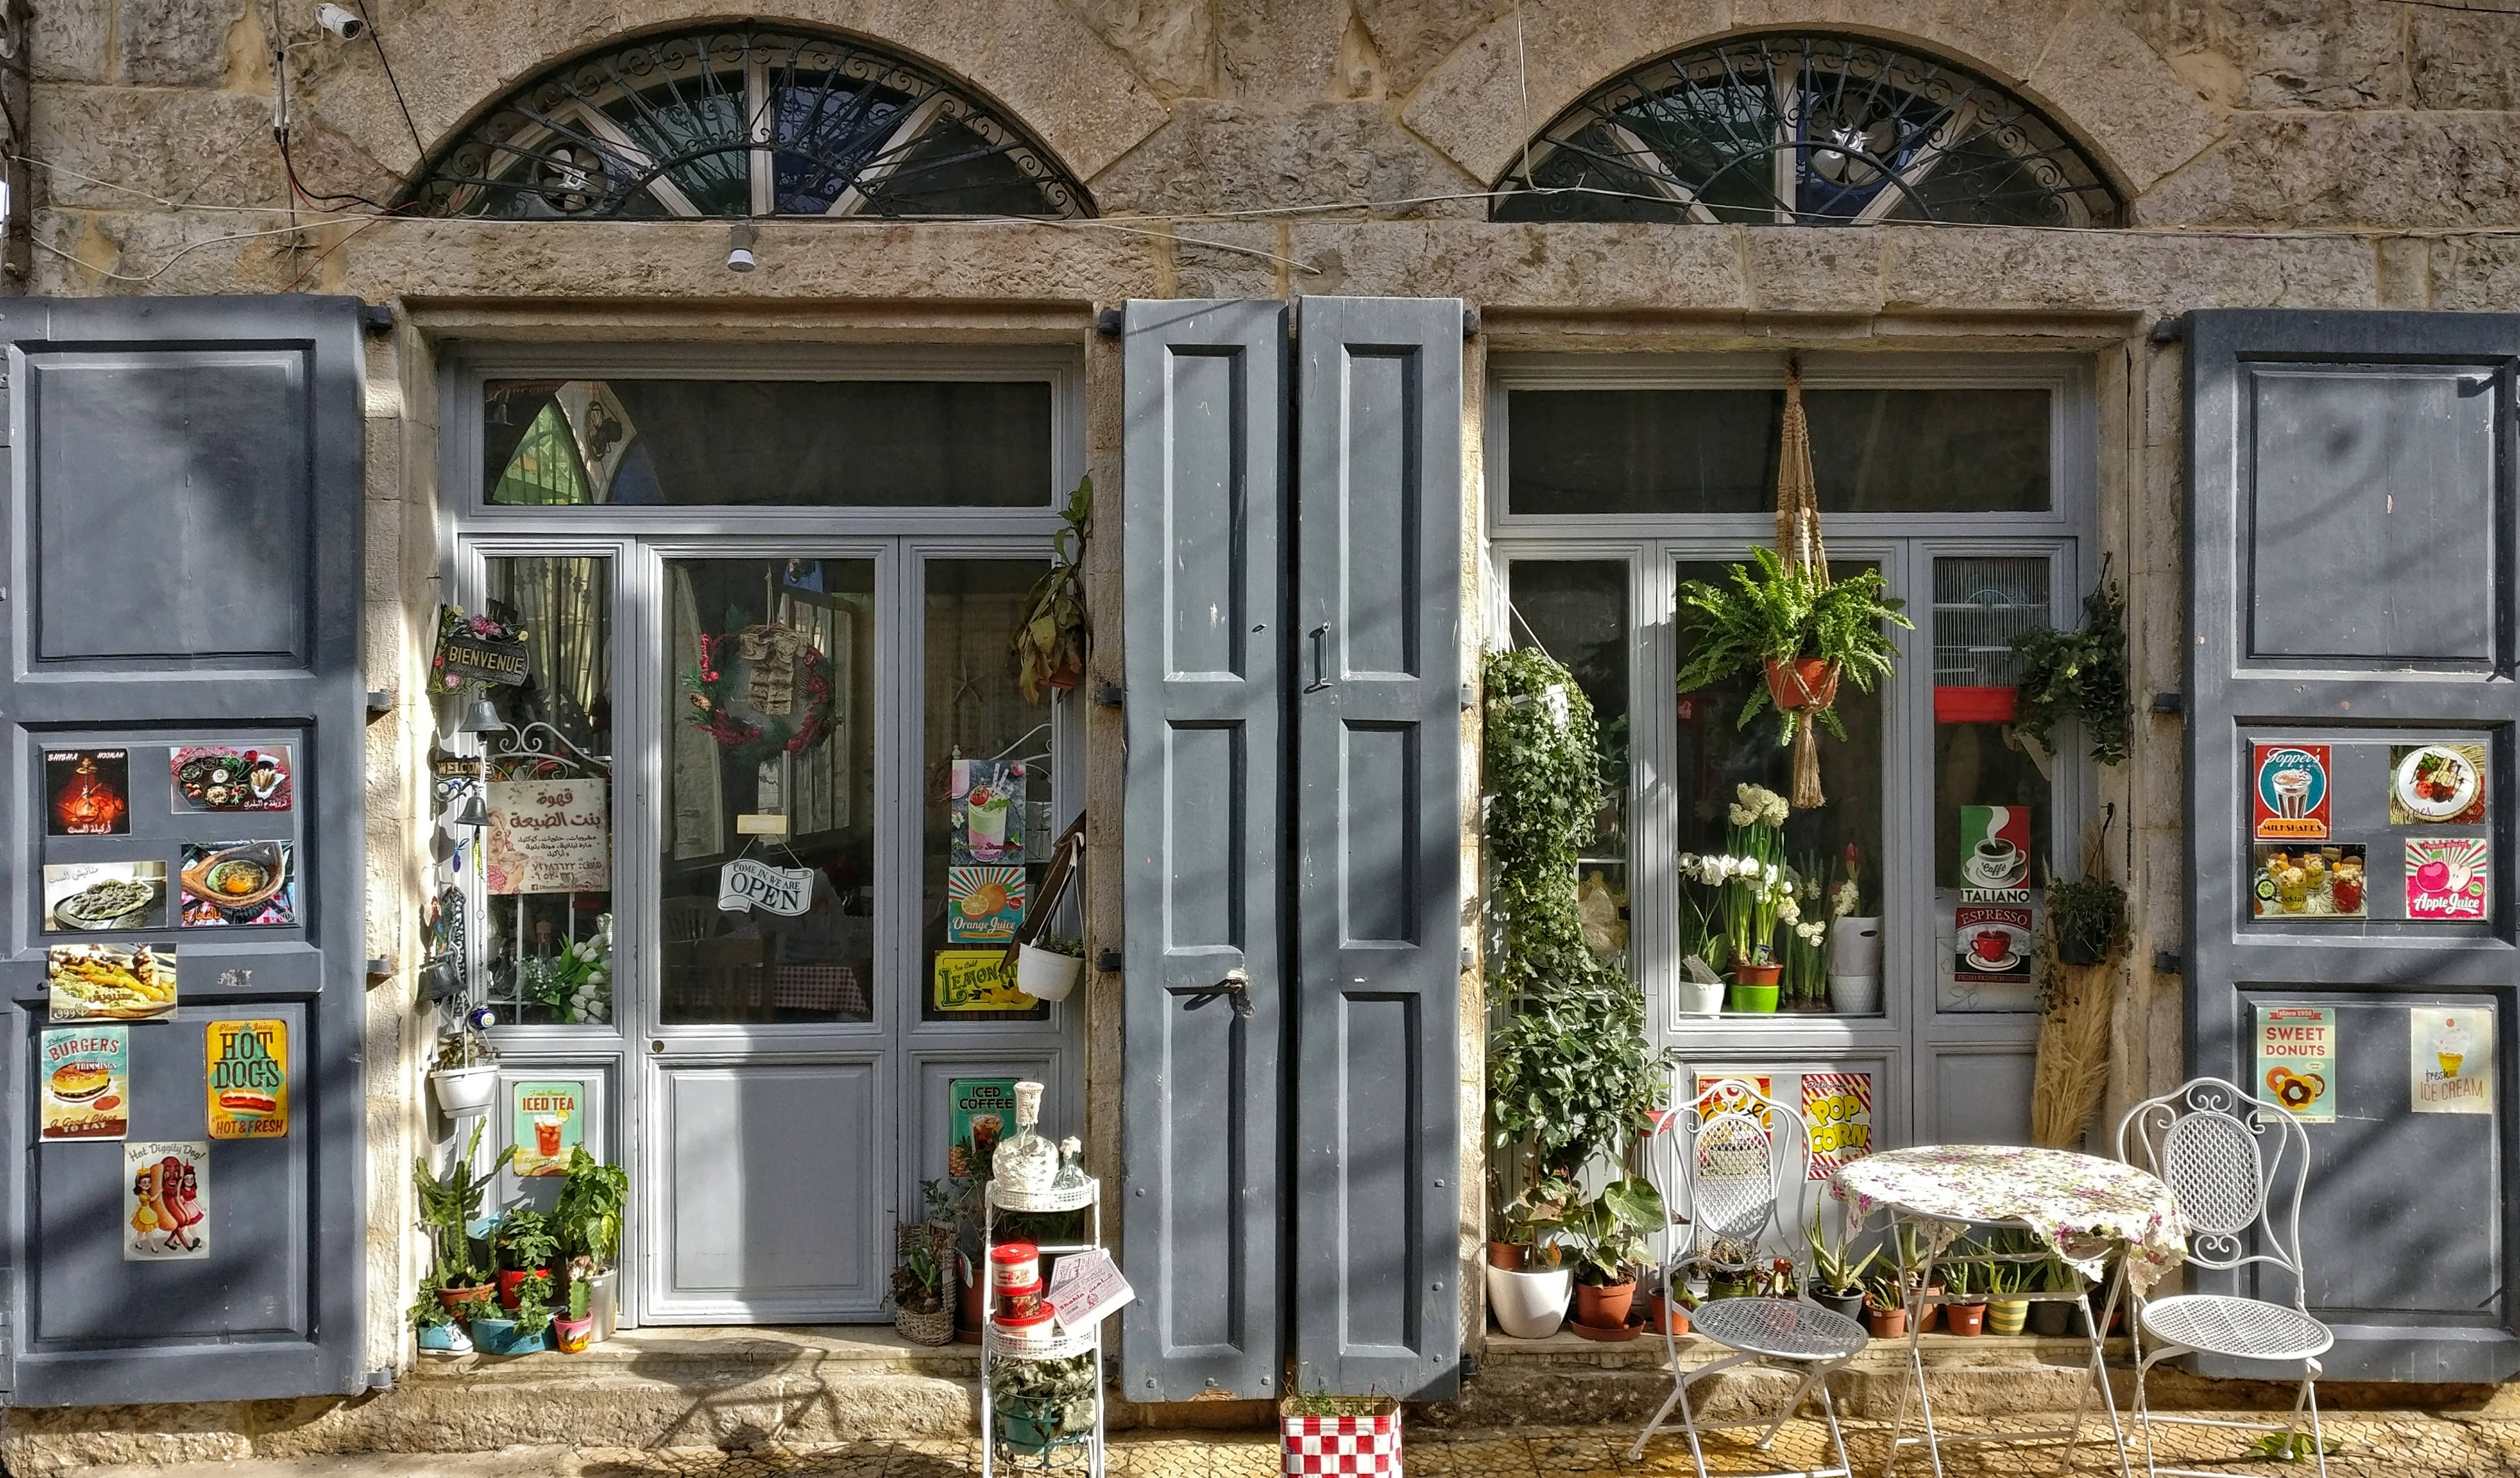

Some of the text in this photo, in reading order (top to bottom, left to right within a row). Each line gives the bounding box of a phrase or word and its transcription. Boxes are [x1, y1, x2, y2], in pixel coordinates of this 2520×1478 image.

[448, 646, 525, 675] BIENVENUE
[47, 753, 79, 761] SHISHA
[2264, 747, 2320, 767] Topper's
[437, 761, 492, 774] WELCOME
[537, 788, 574, 807] قهوة
[510, 812, 601, 830] بنت الضيعة
[67, 824, 89, 833] الست
[1982, 862, 2006, 876] Caffè
[733, 864, 756, 874] COME
[770, 875, 782, 887] WE
[783, 881, 800, 890] ARE
[731, 872, 802, 911] OPEN
[1960, 890, 2030, 903] ITALIANO
[2414, 892, 2480, 914] Apple Juice
[1960, 909, 2028, 926] ESPRESSO
[952, 916, 1016, 934] Orange Juice
[964, 960, 978, 969] Cold
[219, 1024, 244, 1032] Plump
[253, 1022, 274, 1031] Juicy
[2266, 1027, 2325, 1041] SWEET
[48, 1038, 119, 1061] BURGERS
[220, 1032, 273, 1061] HOT
[2266, 1045, 2325, 1056] DONUTS
[76, 1062, 117, 1070] TRIMMINGS
[214, 1060, 280, 1089] DOGS
[2426, 1068, 2449, 1083] fresh
[972, 1086, 1001, 1098] ICED
[1806, 1081, 1846, 1090] Delicious
[2420, 1078, 2483, 1102] ICE CREAM
[522, 1097, 575, 1111] ICED TEA
[959, 1098, 1014, 1110] COFFEE
[1810, 1095, 1861, 1126] POP
[62, 1115, 89, 1127] Good
[91, 1113, 118, 1123] Place
[63, 1121, 107, 1133] TO EAT
[215, 1121, 238, 1134] HOT
[248, 1120, 283, 1133] FRESH
[1810, 1122, 1869, 1154] CORN
[129, 1143, 207, 1162] Hot Diggity Dog!
